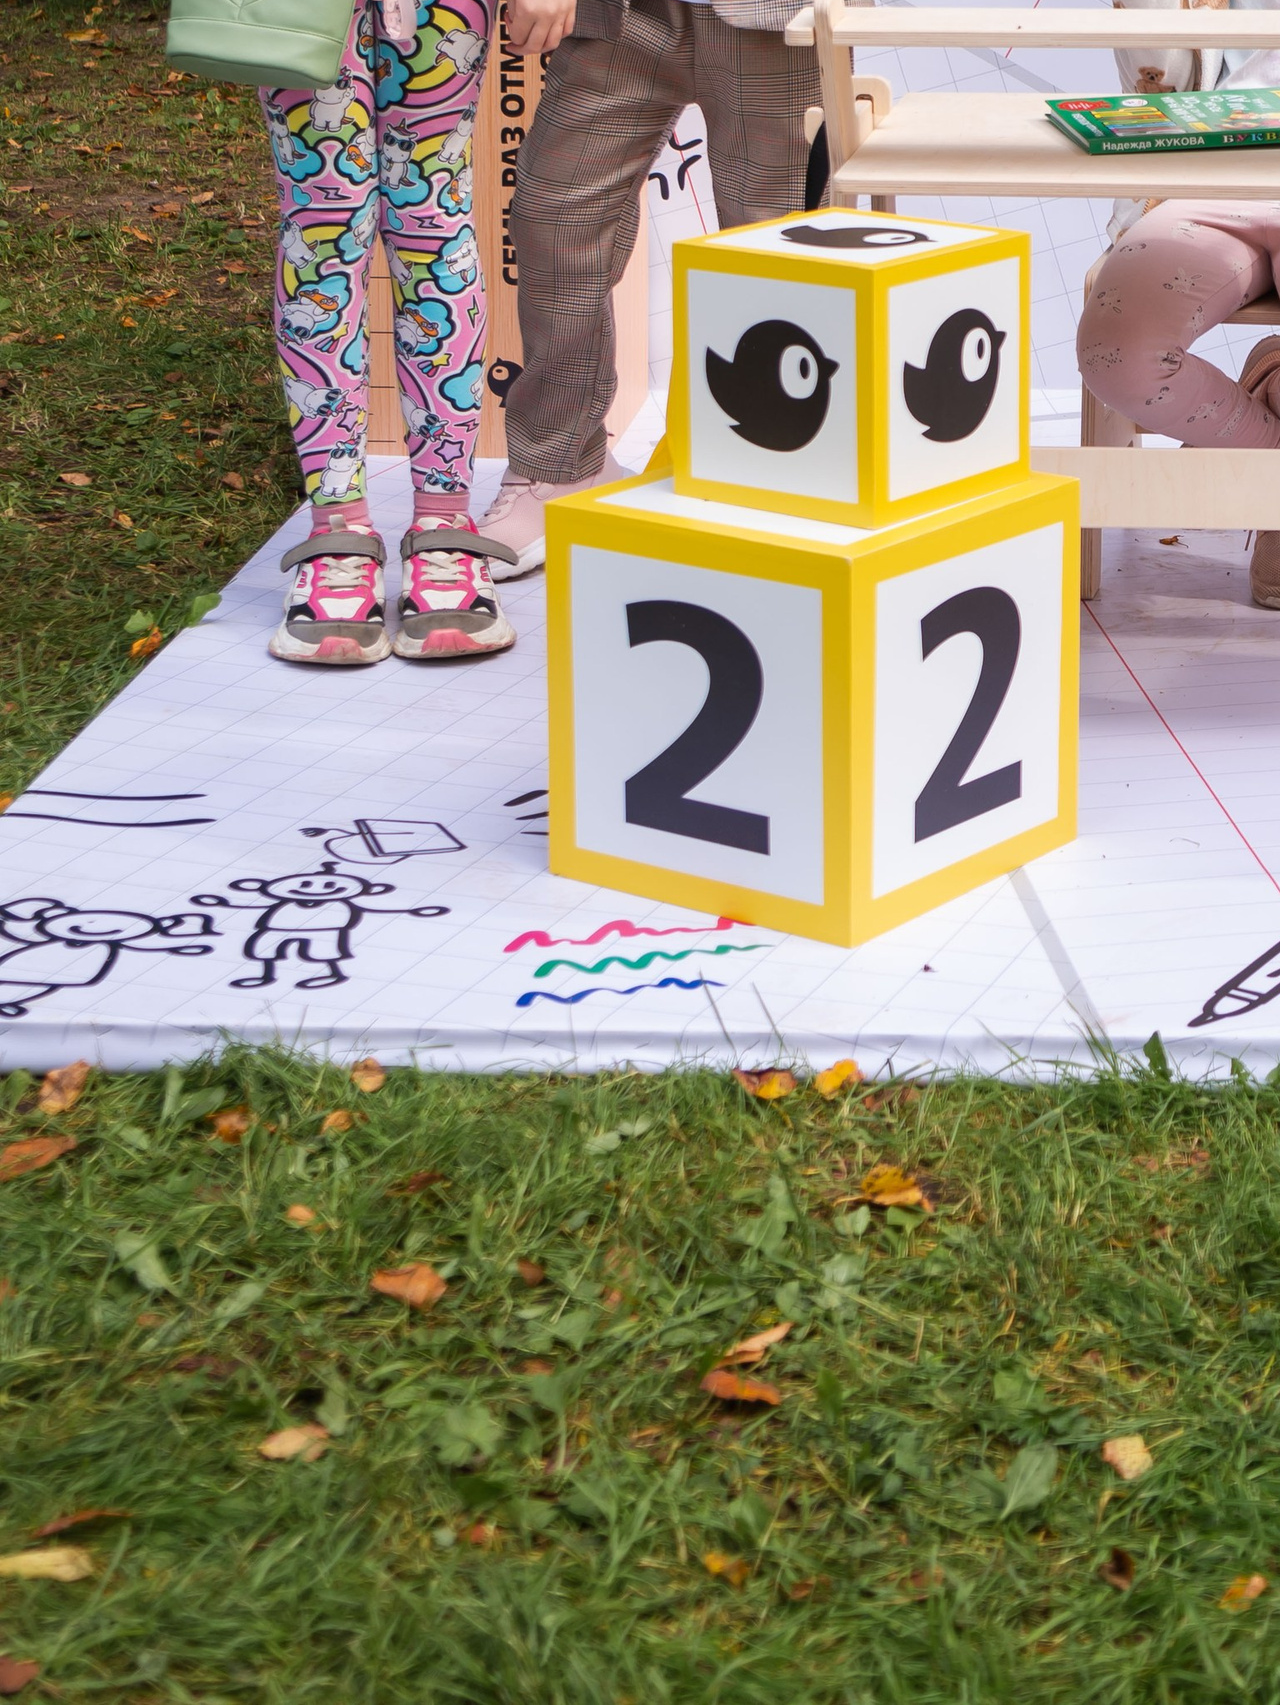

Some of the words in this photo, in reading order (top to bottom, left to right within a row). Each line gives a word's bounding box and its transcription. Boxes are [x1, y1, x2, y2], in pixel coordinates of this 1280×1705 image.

[1102, 141, 1152, 151] Надежда
[1154, 136, 1205, 147] ЖУКОВА
[625, 599, 771, 856] 2
[914, 586, 1023, 844] 2
